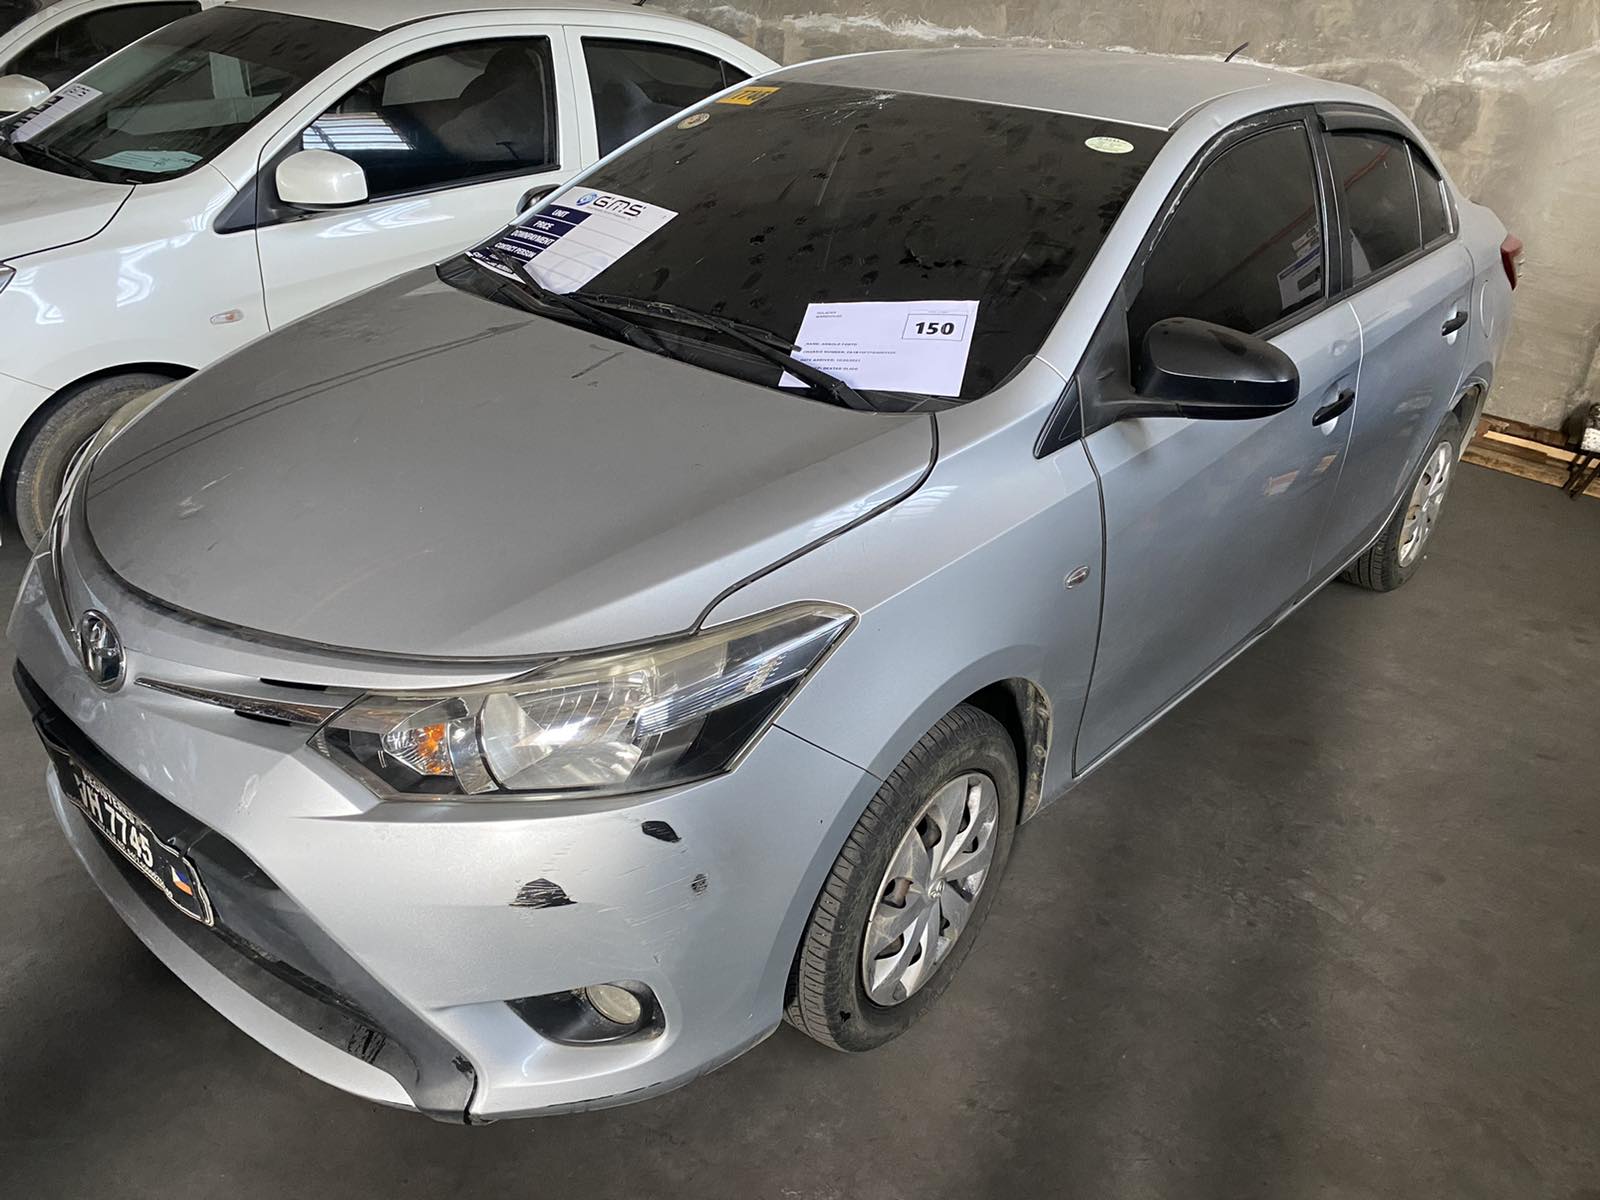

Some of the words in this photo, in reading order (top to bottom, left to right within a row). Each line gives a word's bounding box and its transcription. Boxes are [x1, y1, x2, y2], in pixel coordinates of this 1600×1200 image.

[551, 208, 570, 218] UNIT
[592, 195, 646, 217] GMS
[532, 219, 555, 231] PRICE
[493, 241, 518, 253] CONTACT
[513, 246, 537, 259] PERSON
[915, 321, 955, 336] 150
[103, 801, 154, 868] 7745
